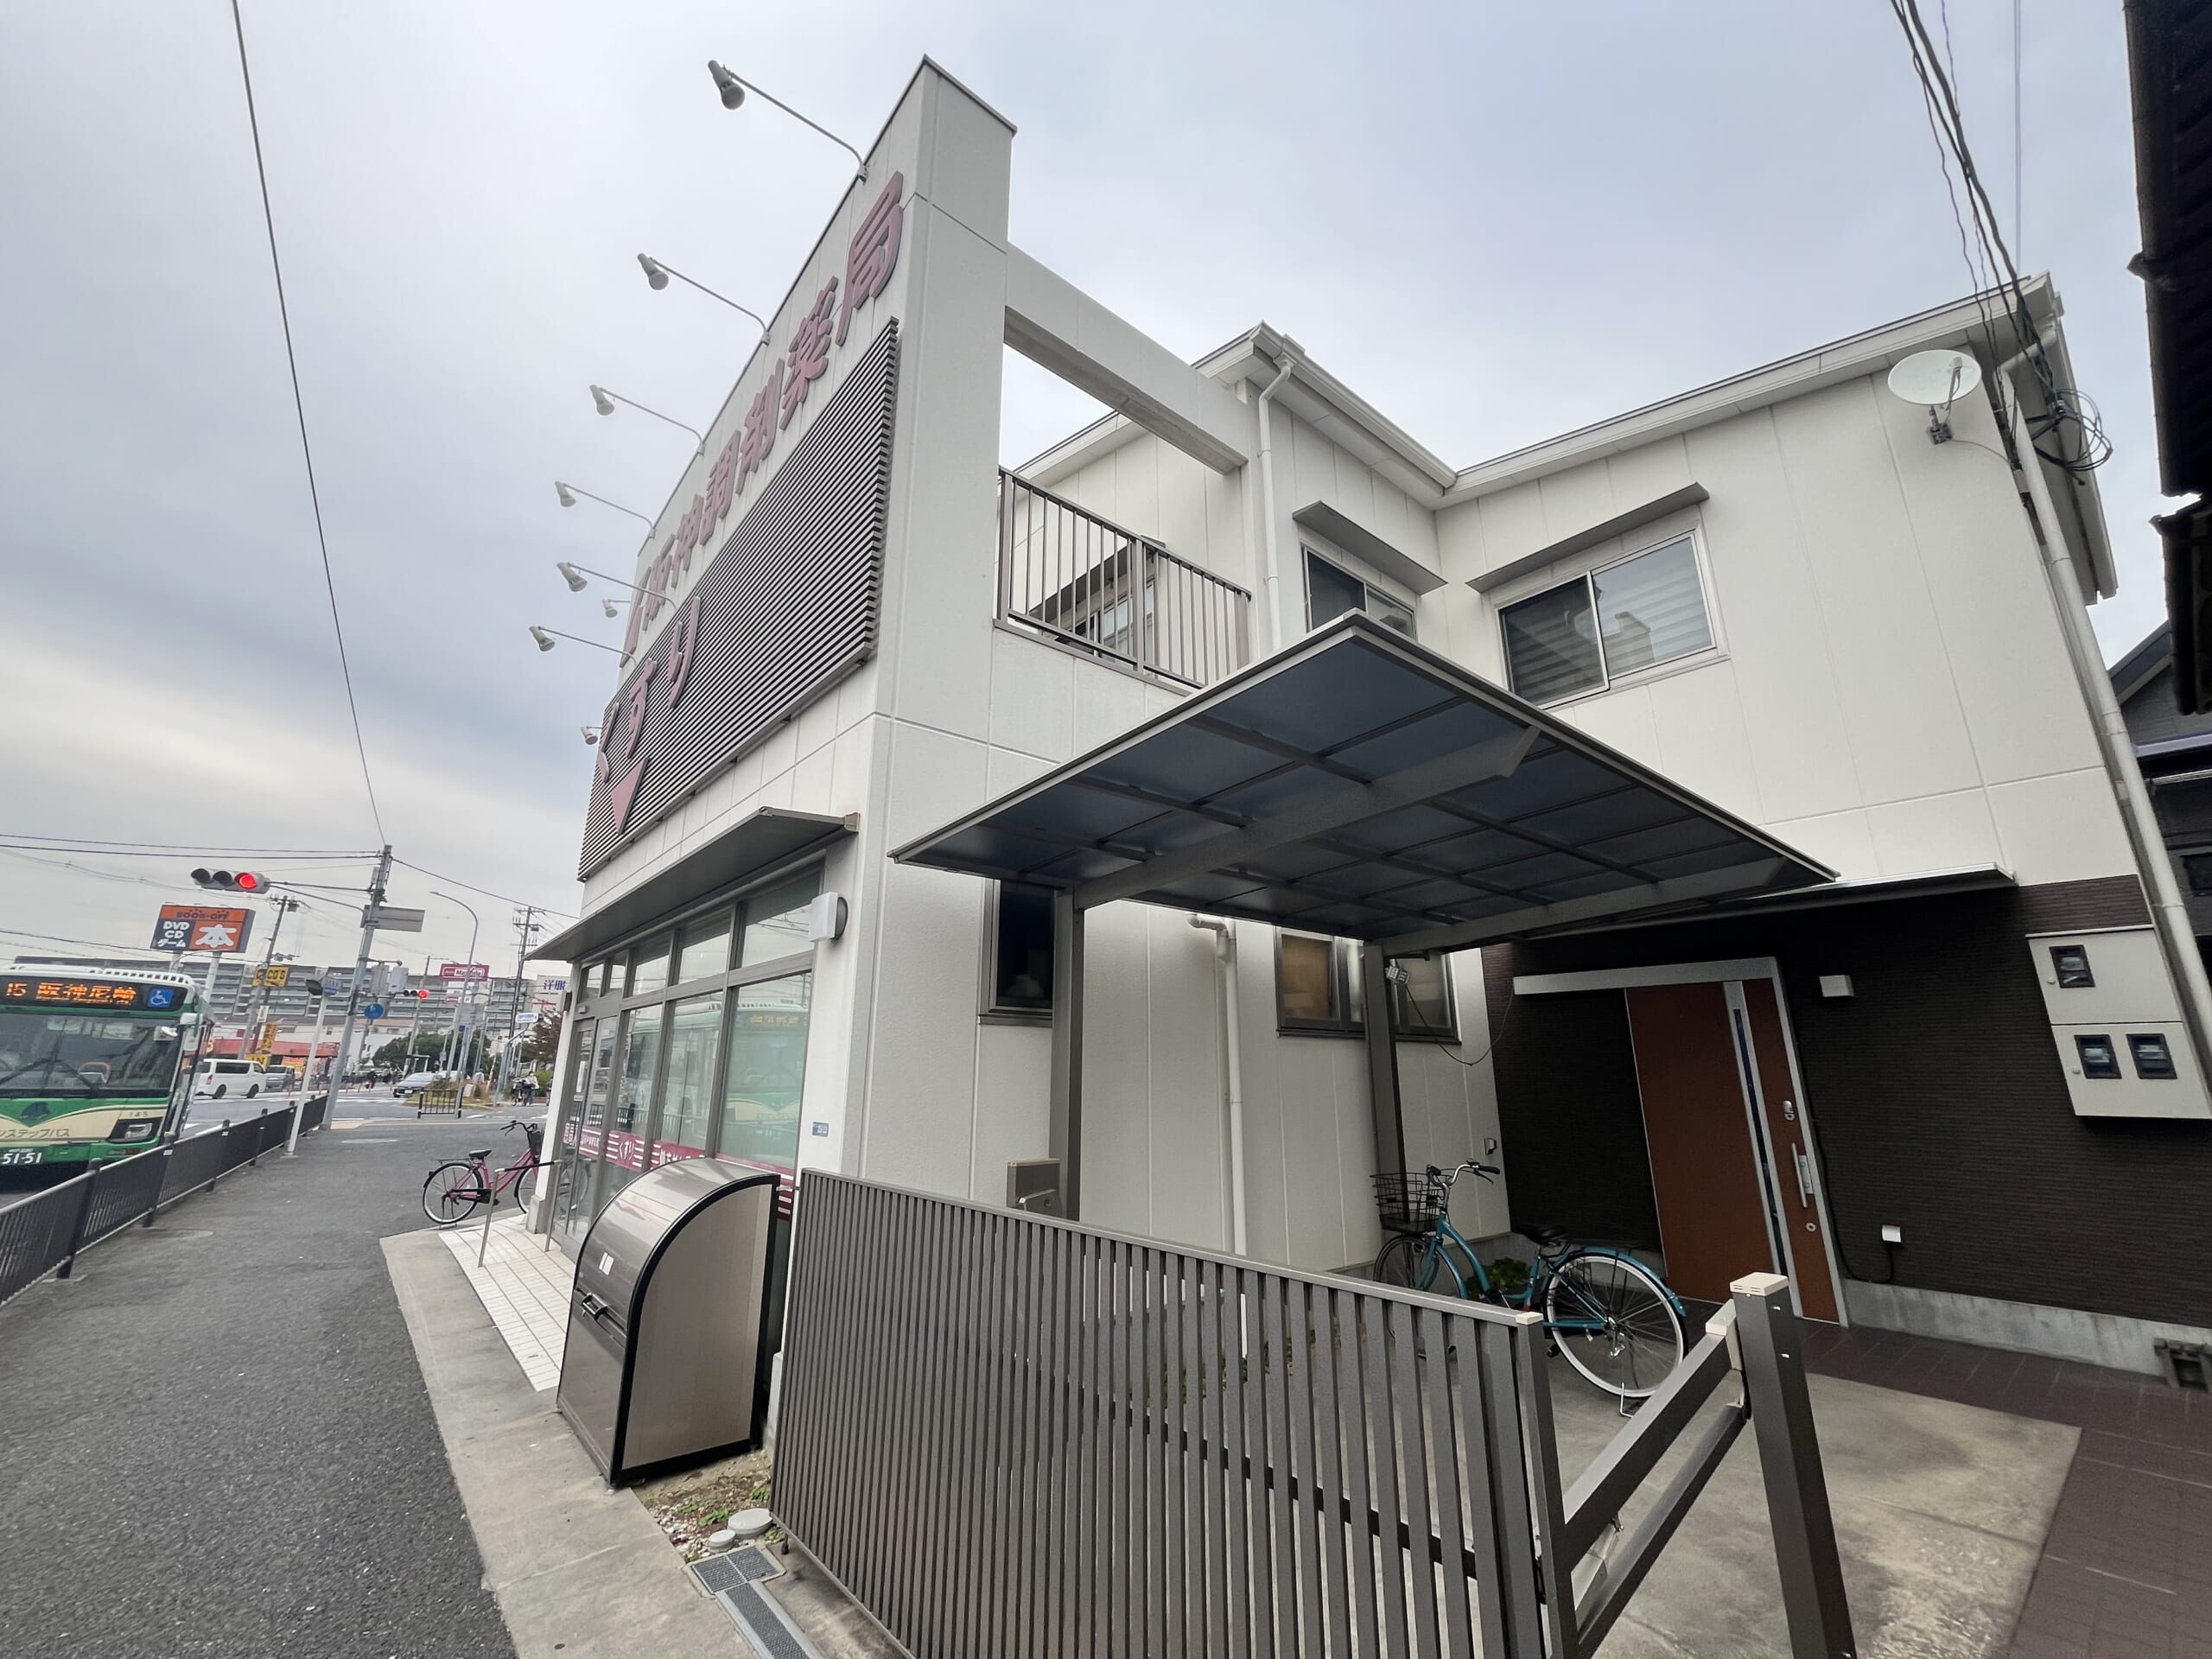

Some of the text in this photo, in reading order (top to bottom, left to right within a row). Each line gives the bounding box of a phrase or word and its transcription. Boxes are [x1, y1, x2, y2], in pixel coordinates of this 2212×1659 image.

[596, 596, 701, 783] くすり
[176, 910, 229, 920] BOOK-OFF
[162, 921, 190, 931] DVD
[164, 931, 184, 939] CD
[194, 924, 237, 949] 本
[157, 938, 187, 948] ゲーム
[543, 979, 566, 991] 洋服
[2, 1152, 42, 1165] 51-51
